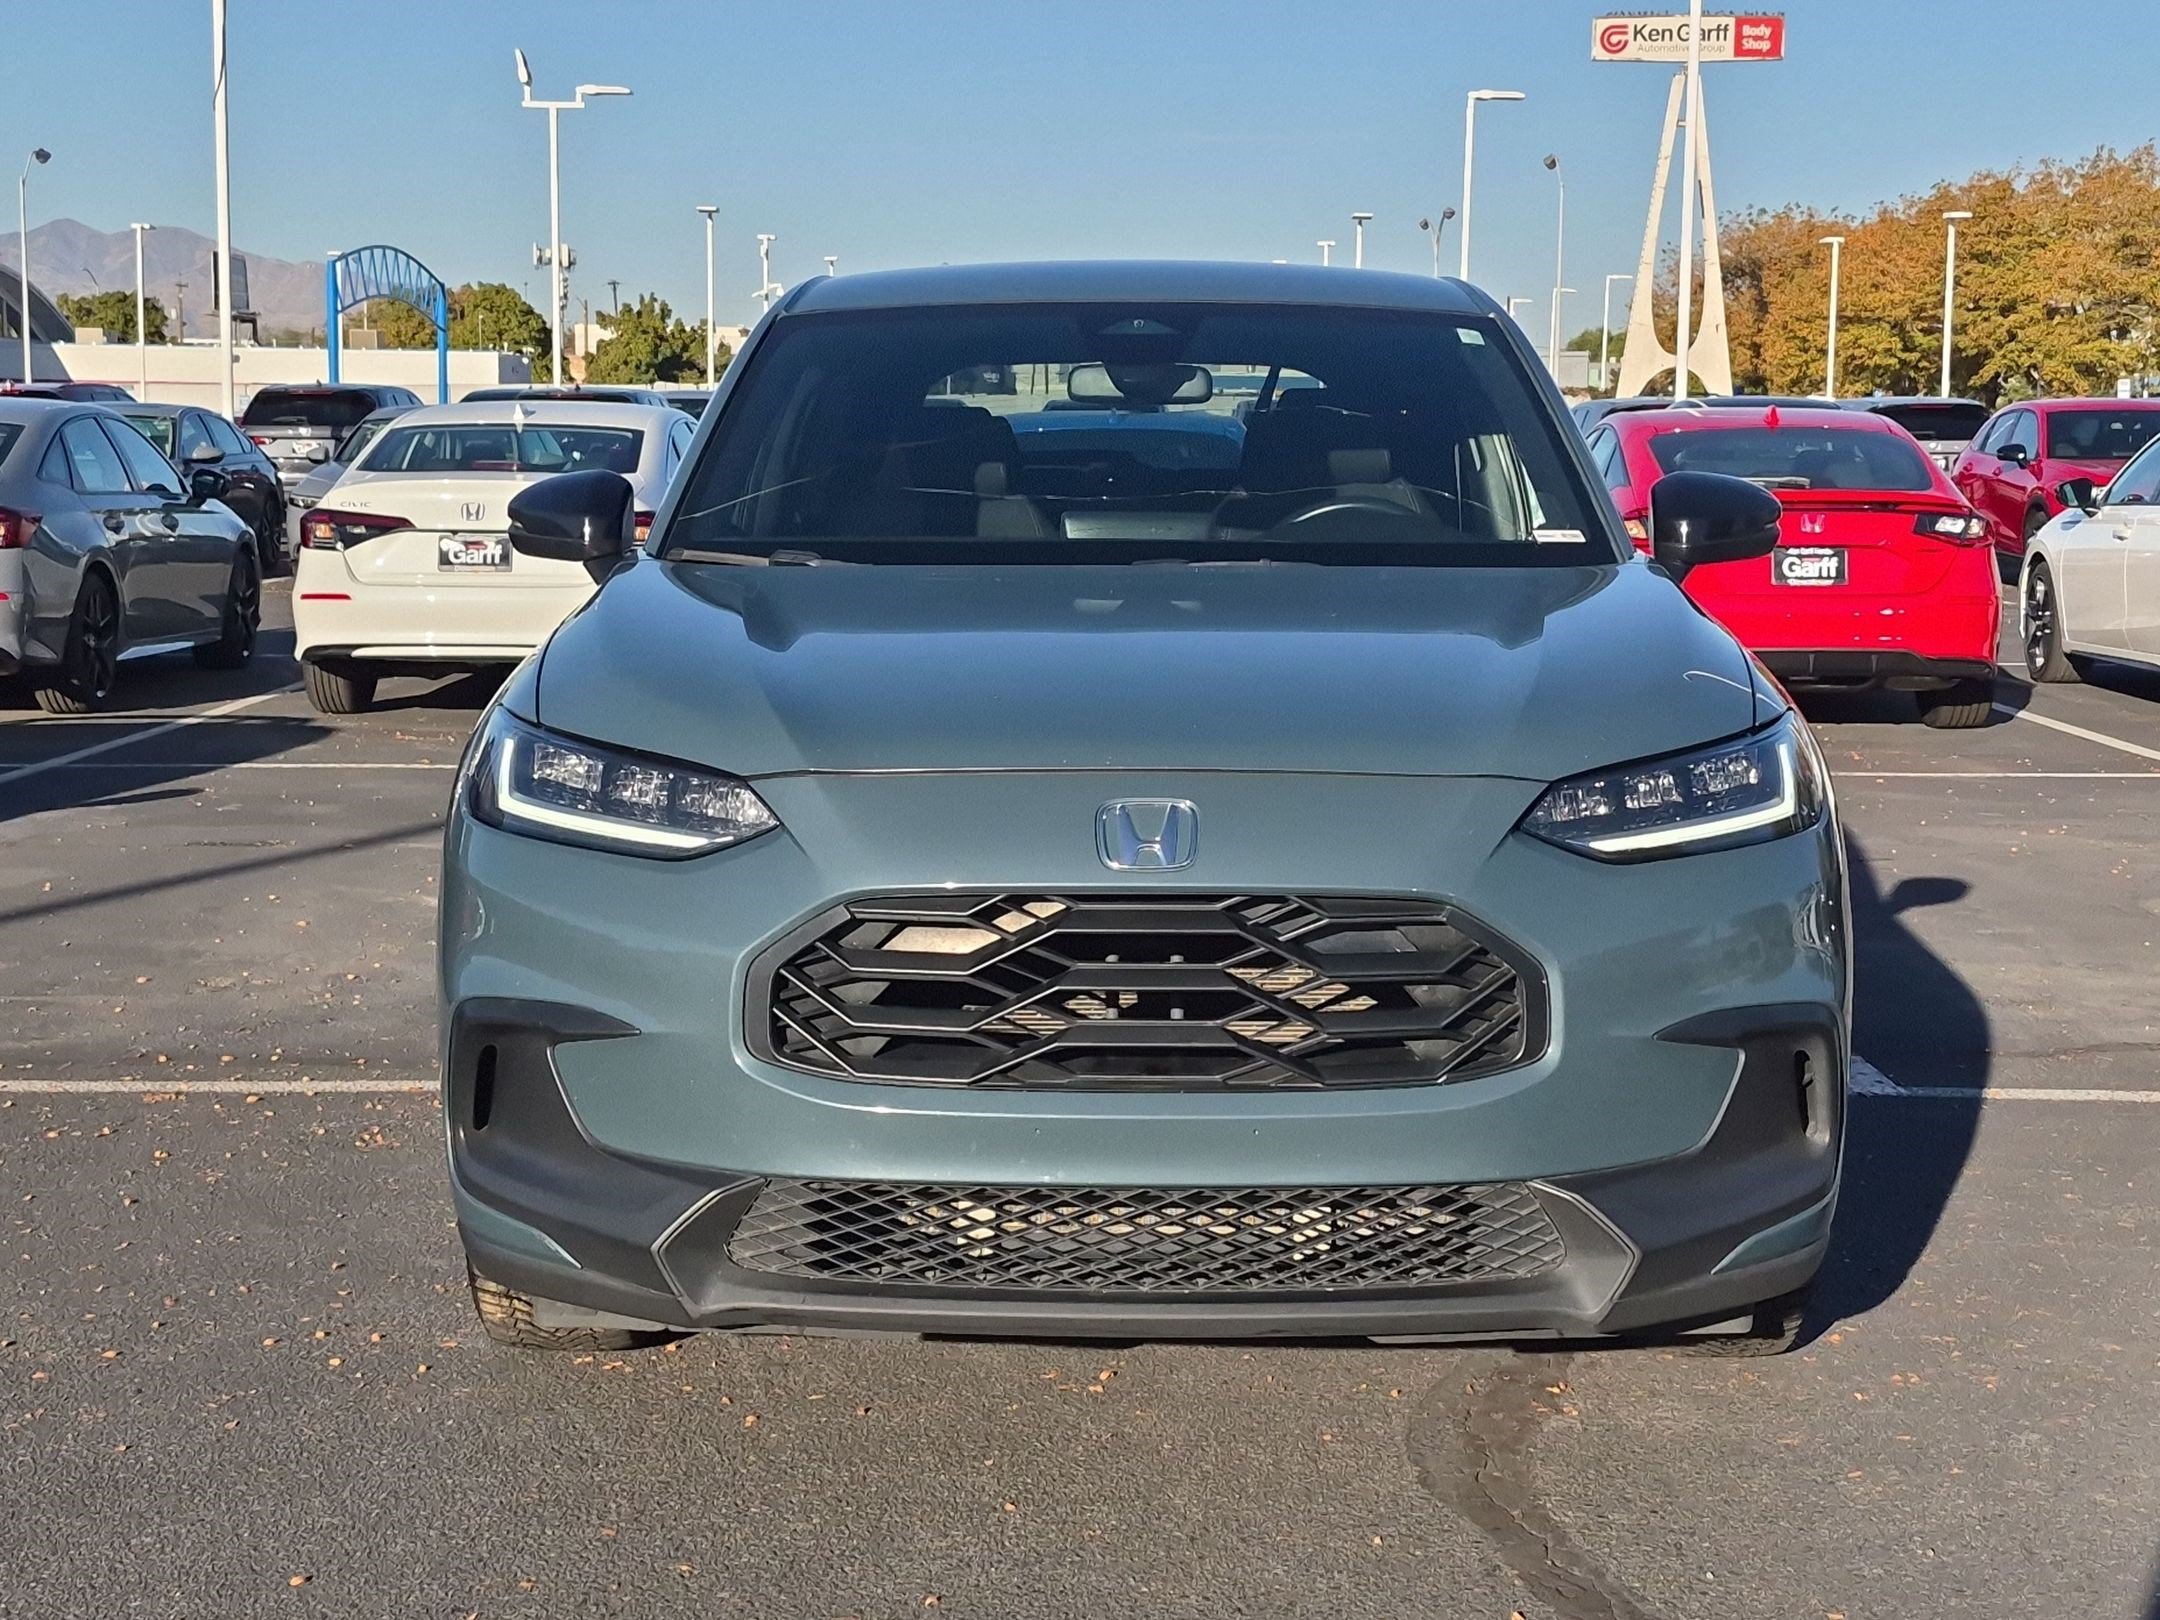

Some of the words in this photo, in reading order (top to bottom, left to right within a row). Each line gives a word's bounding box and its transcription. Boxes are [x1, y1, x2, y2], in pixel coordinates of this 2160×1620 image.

[1633, 24, 1673, 42] Ken
[1742, 24, 1772, 39] Body
[1742, 37, 1771, 53] Shop
[448, 541, 502, 564] Garff
[1782, 556, 1839, 577] Garff
